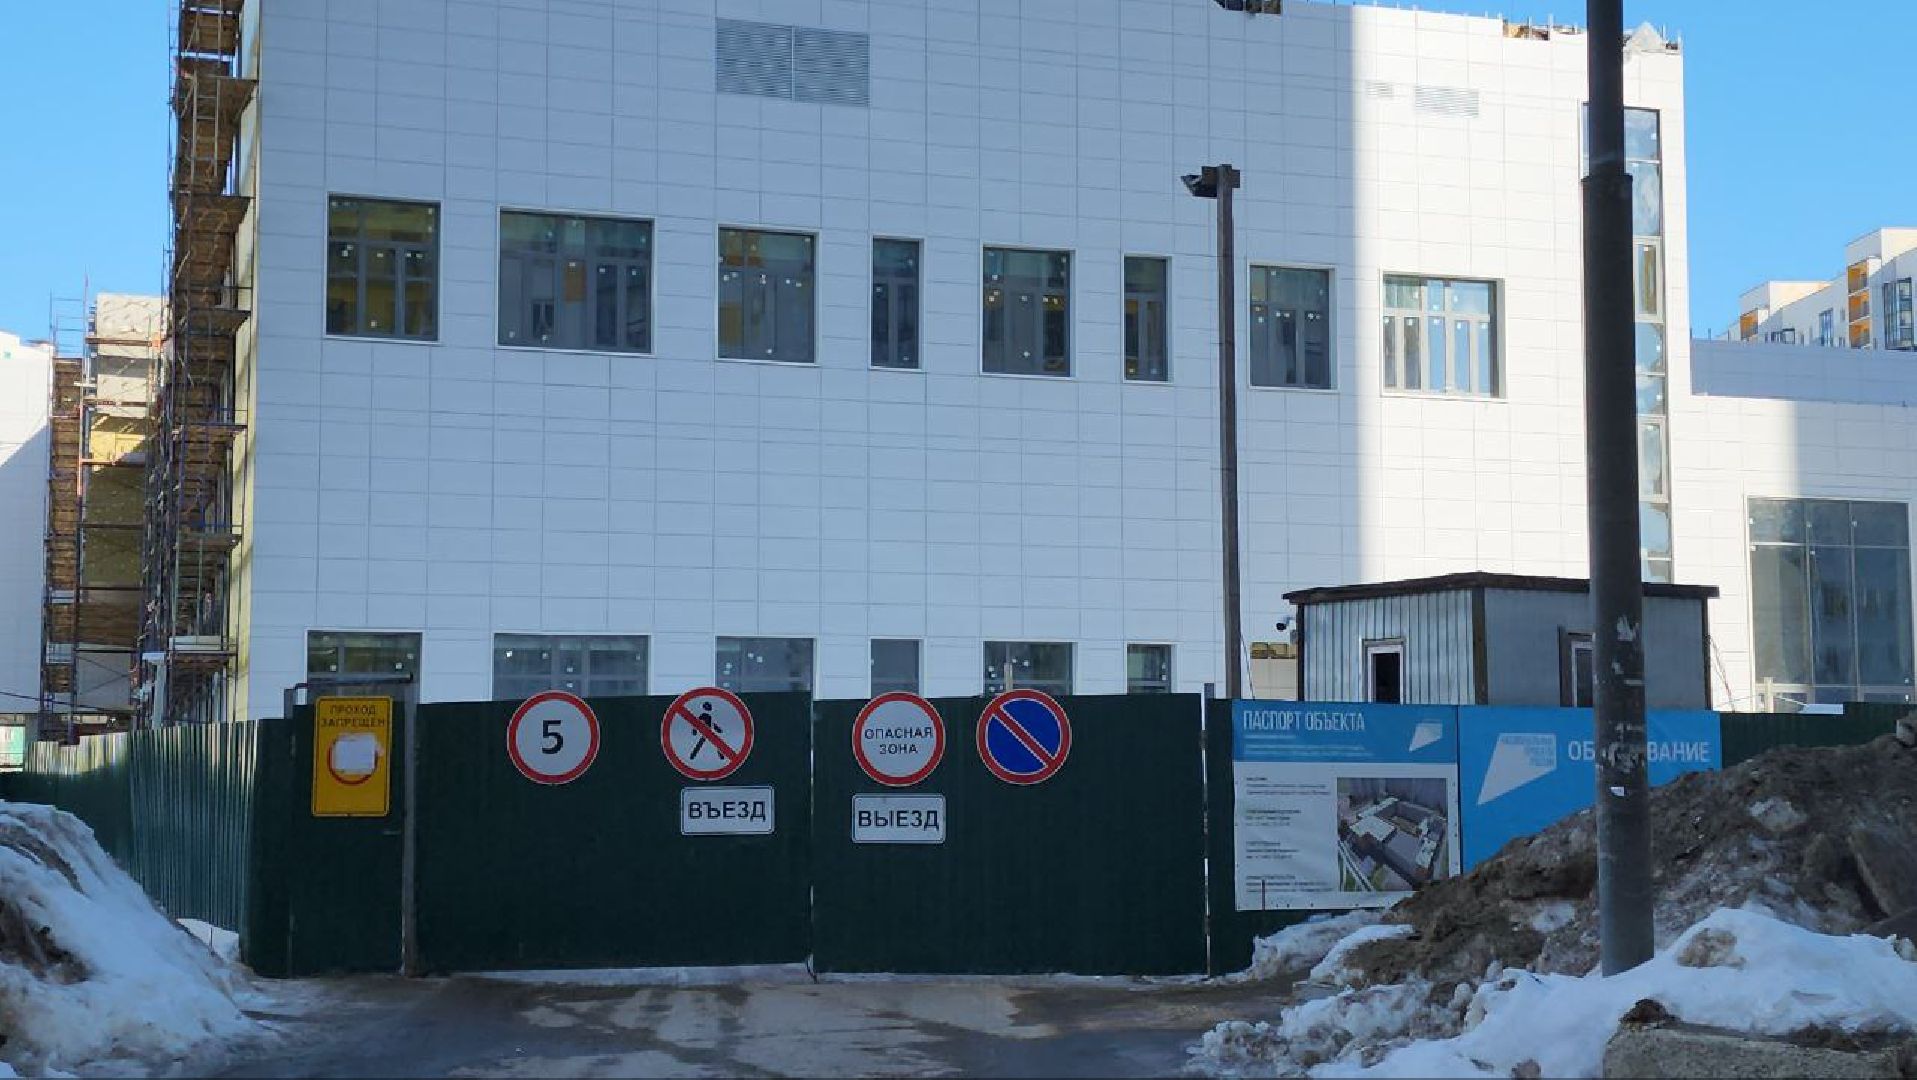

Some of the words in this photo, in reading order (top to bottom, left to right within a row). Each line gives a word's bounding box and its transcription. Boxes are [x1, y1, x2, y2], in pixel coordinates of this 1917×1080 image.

[329, 704, 376, 715] ПРОХОД
[1243, 711, 1300, 730] ПАСПОРТ
[1305, 712, 1365, 731] ОБЪЕКТА
[541, 720, 564, 755] 5
[865, 727, 933, 739] ОПАСНАЯ
[880, 743, 918, 754] ЗОНА
[1568, 740, 1711, 762] ОБВАНИЕ
[689, 801, 766, 822] ВЪЕЗД
[858, 810, 939, 831] ВЫЕЗД
